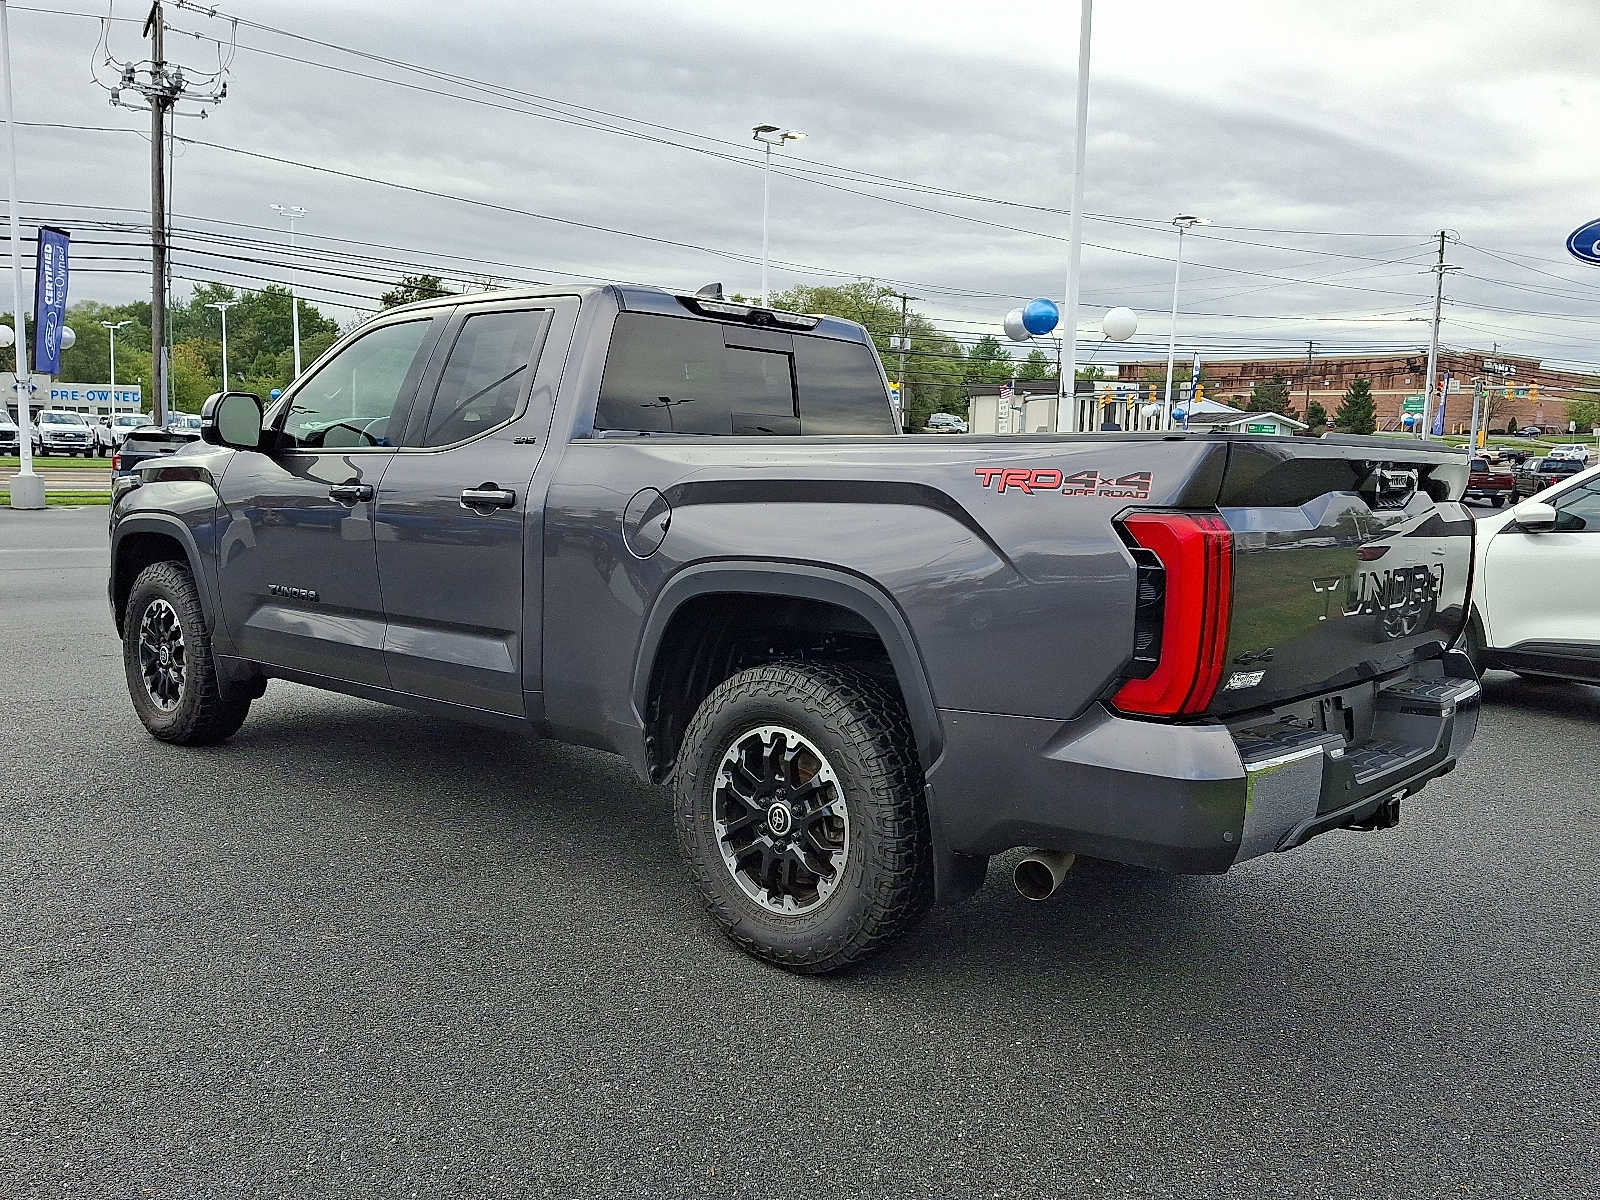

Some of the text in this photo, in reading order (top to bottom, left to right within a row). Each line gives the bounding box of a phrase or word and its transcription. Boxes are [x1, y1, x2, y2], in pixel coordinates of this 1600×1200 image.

[44, 244, 53, 305] CERTIFIED
[55, 245, 65, 309] Pre-Owned
[50, 390, 140, 402] PRE-OWNED
[974, 467, 1153, 497] TRD 4x4
[1061, 488, 1149, 500] OFF ROAD
[1312, 563, 1445, 621] TUNDRA
